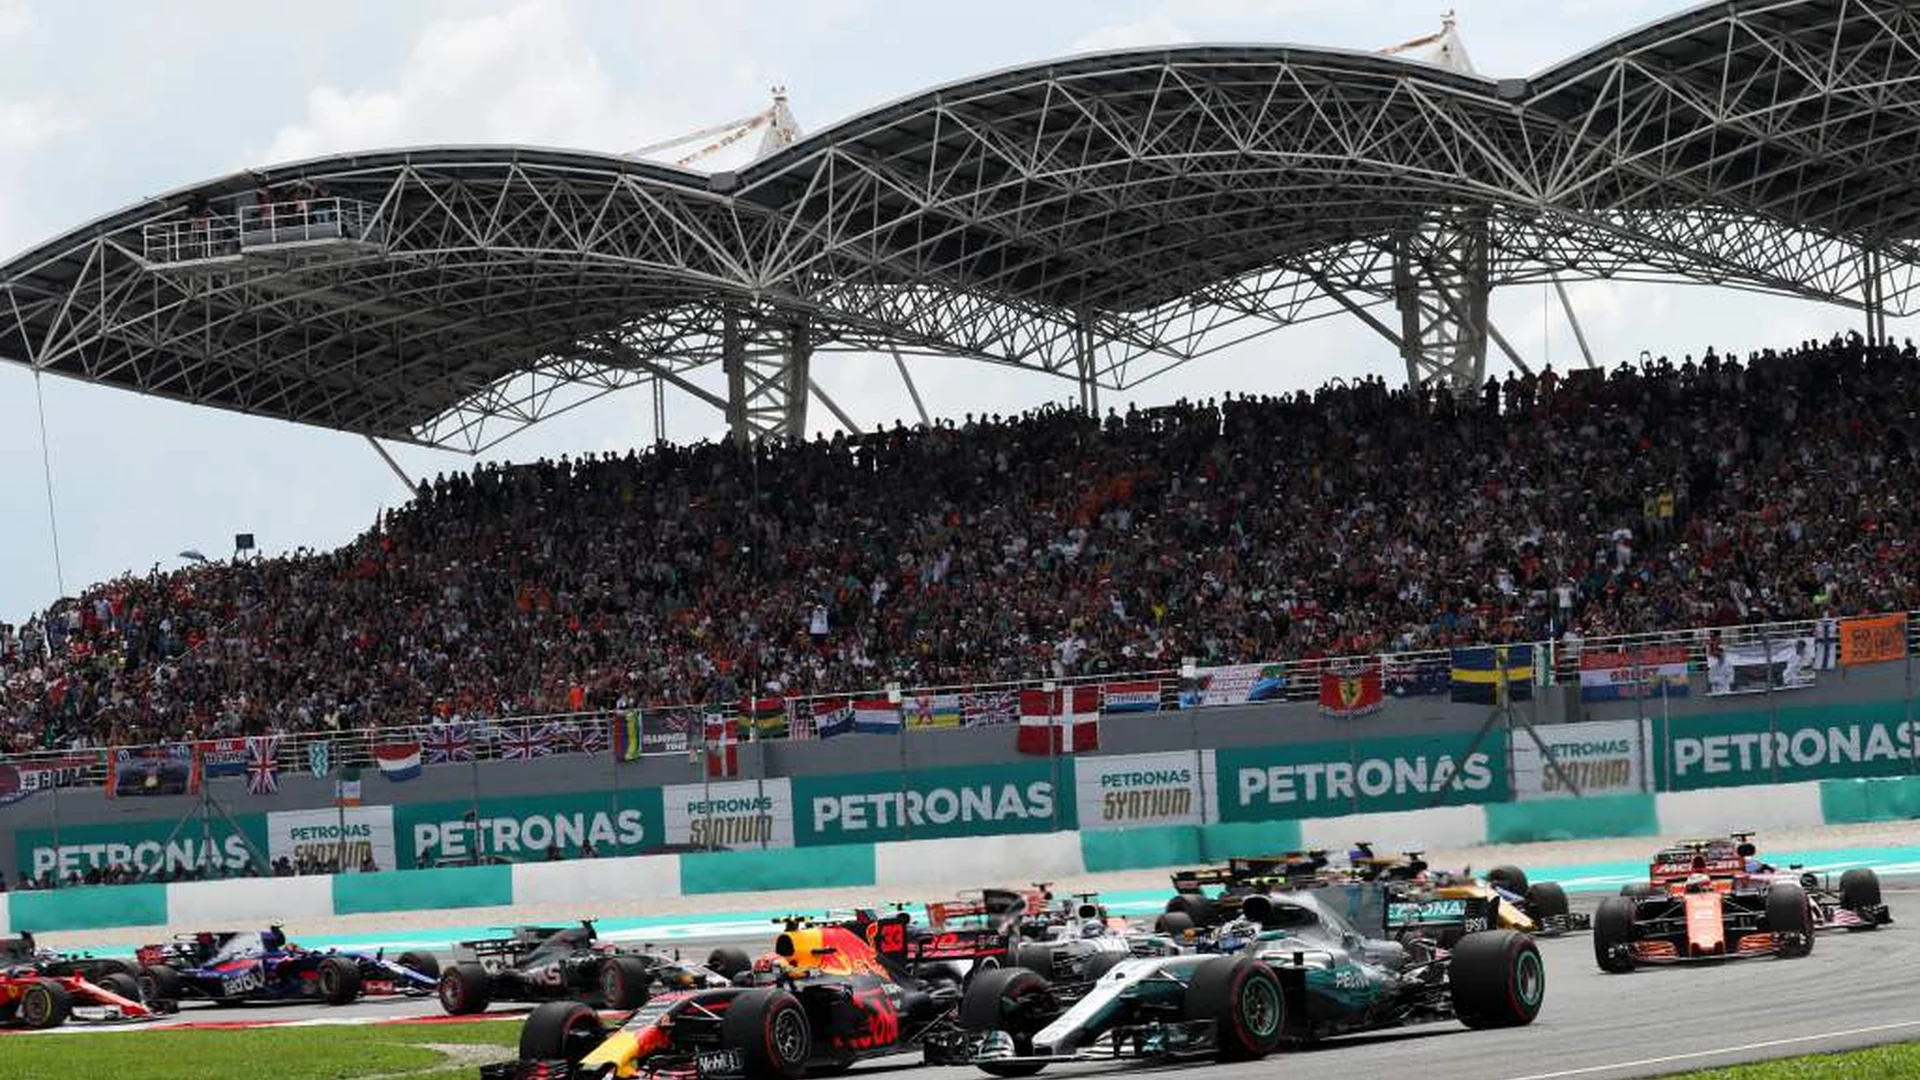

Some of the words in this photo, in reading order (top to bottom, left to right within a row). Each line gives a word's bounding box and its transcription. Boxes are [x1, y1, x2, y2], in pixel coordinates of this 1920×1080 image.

[1674, 721, 1920, 776] PETRONAS
[1100, 770, 1191, 787] PETRONAS
[1239, 752, 1493, 806] PETRONAS
[1542, 759, 1630, 791] SYNTIUM
[687, 796, 772, 814] PETRONAS
[813, 781, 1054, 832] PETRONAS
[1102, 788, 1191, 821] SYNTIUM
[291, 824, 372, 841] PETRONAS
[413, 810, 645, 857] PETRONAS
[689, 815, 773, 845] SYNTIUM
[32, 833, 251, 880] PETRONAS
